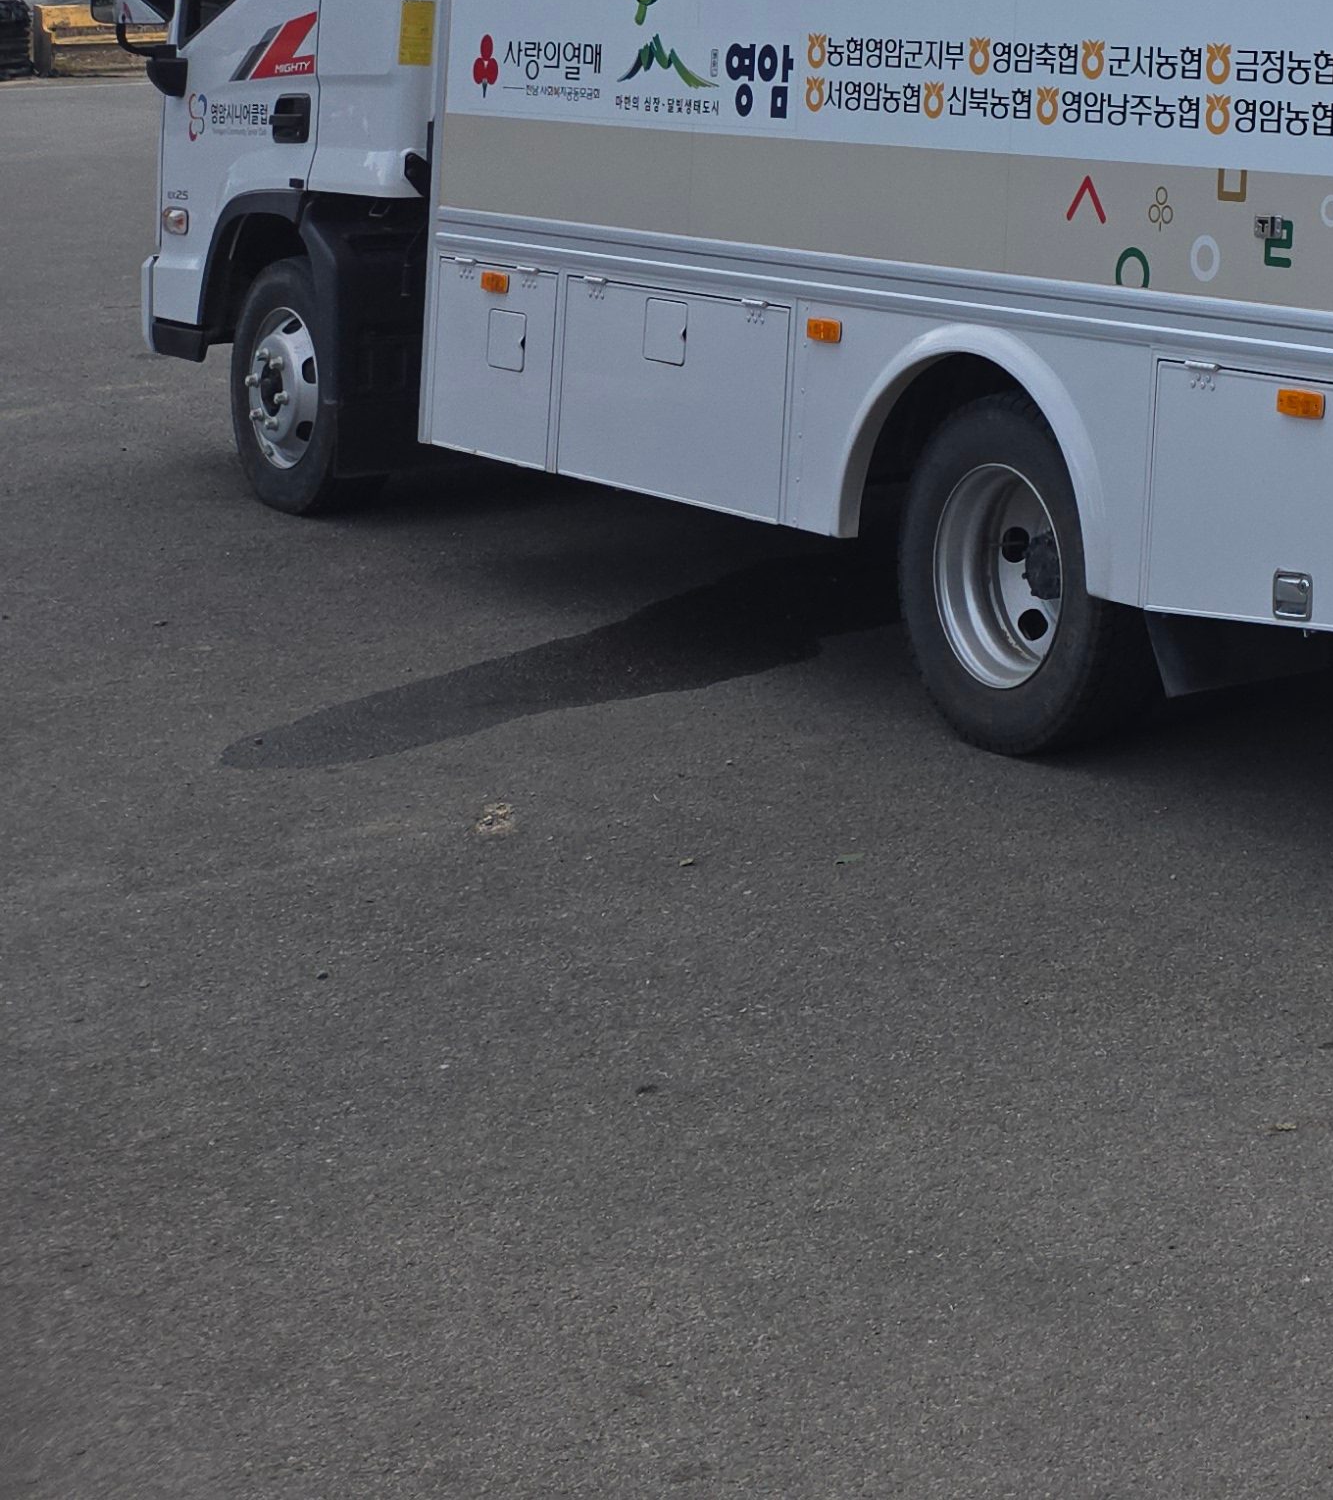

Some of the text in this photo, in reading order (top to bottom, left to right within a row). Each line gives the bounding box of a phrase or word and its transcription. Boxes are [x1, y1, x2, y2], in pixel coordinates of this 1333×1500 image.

[274, 61, 311, 74] MIGHTY
[503, 40, 602, 80] 사랑의열매
[827, 37, 964, 70] 농협영암군지부
[992, 41, 1078, 75] 영암축협
[1108, 45, 1202, 80] 군서농협
[725, 43, 794, 119] 영암
[211, 103, 268, 125] 영암시니어클럽
[823, 80, 921, 114] 서영암농협
[947, 85, 1032, 119] 신북농협
[1062, 90, 1200, 129] 영암낭주농협
